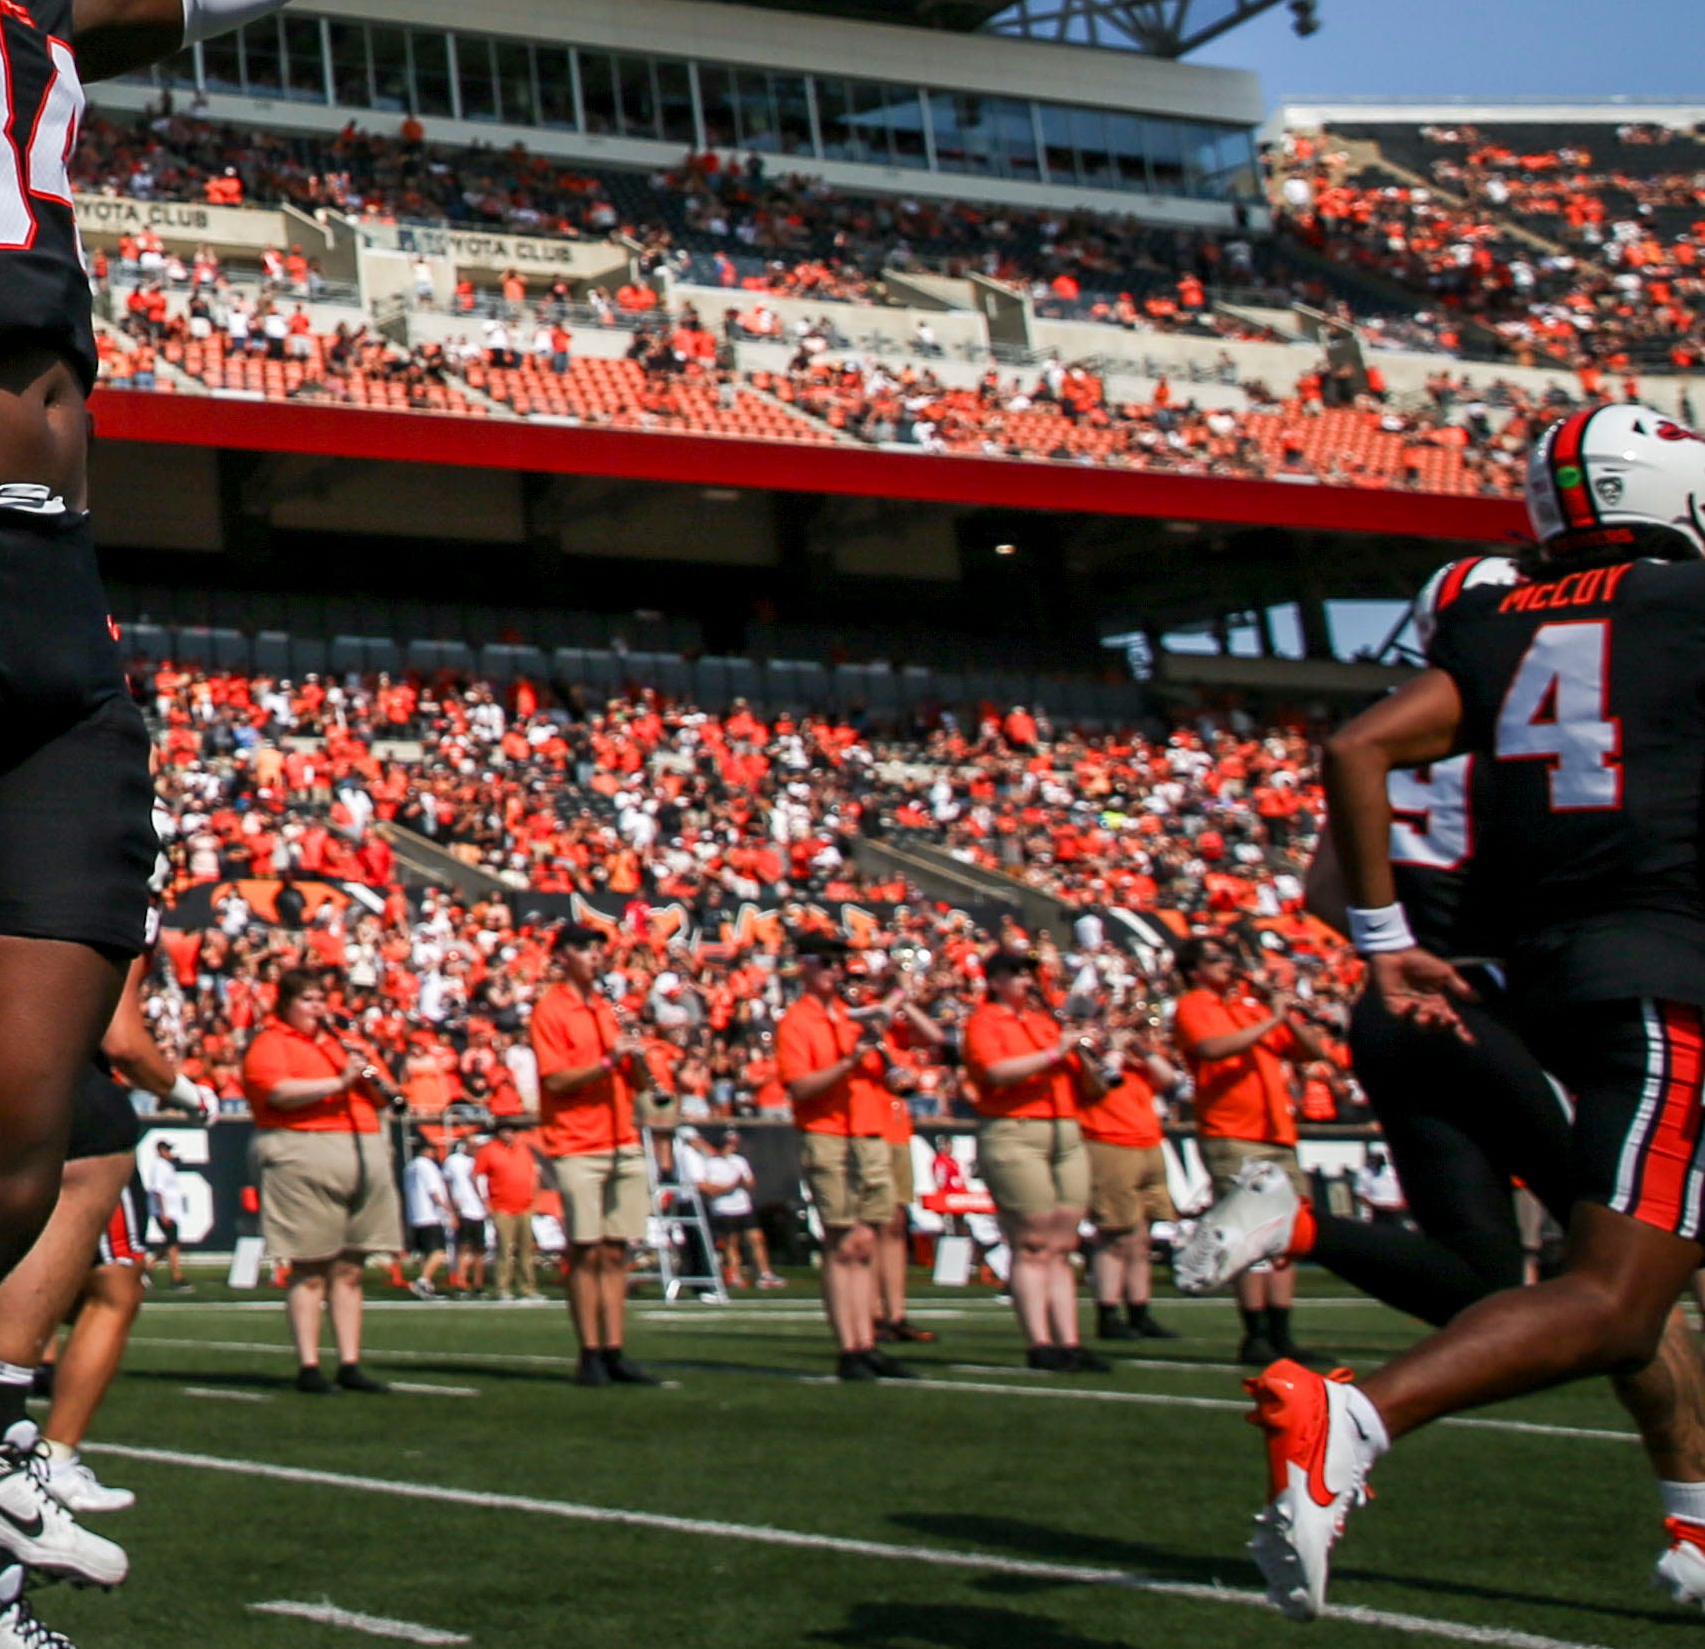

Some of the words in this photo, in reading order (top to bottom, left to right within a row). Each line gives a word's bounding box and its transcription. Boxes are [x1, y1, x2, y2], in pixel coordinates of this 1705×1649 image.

[148, 206, 209, 229] CLUB
[515, 241, 574, 263] CLUB
[1495, 618, 1623, 812] 4
